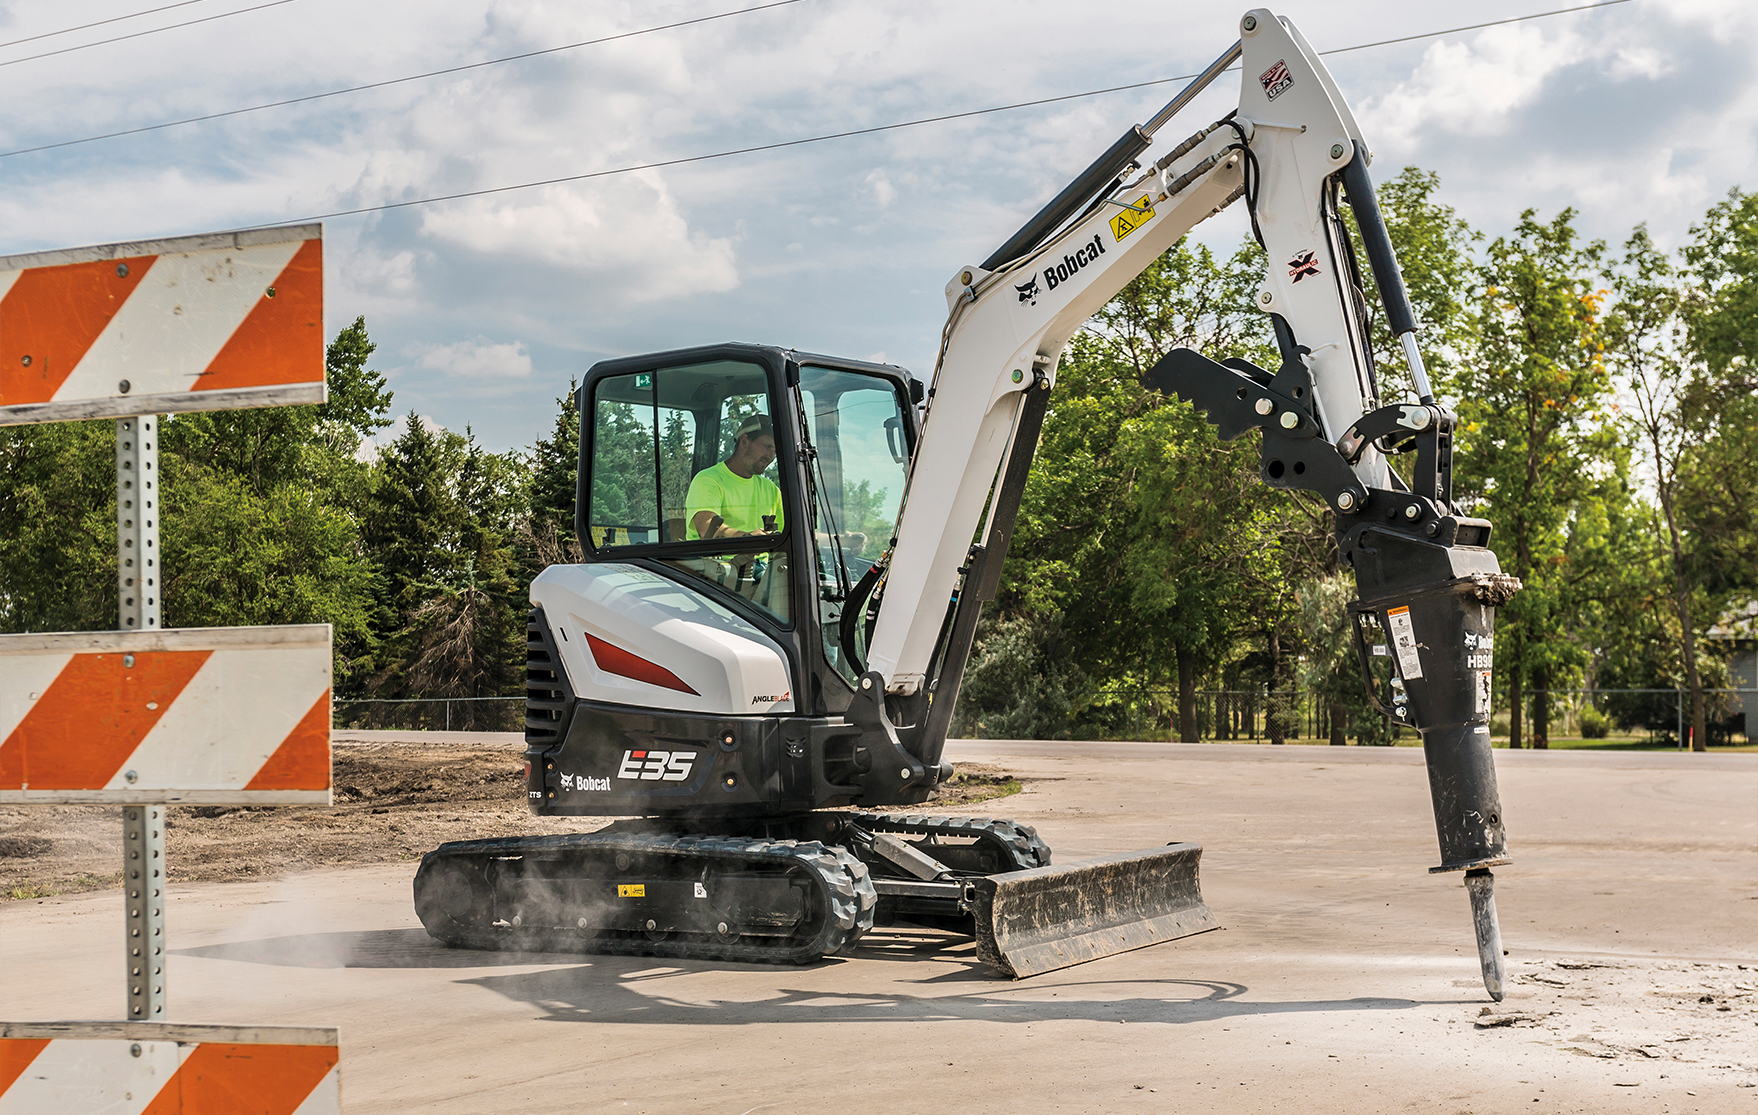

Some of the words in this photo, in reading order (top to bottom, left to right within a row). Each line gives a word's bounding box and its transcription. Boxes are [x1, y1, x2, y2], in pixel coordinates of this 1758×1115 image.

[1269, 79, 1290, 97] USA
[1043, 234, 1106, 291] Bobcat
[617, 750, 697, 781] E35
[576, 776, 611, 791] Bobcat
[529, 791, 542, 799] ZTS
